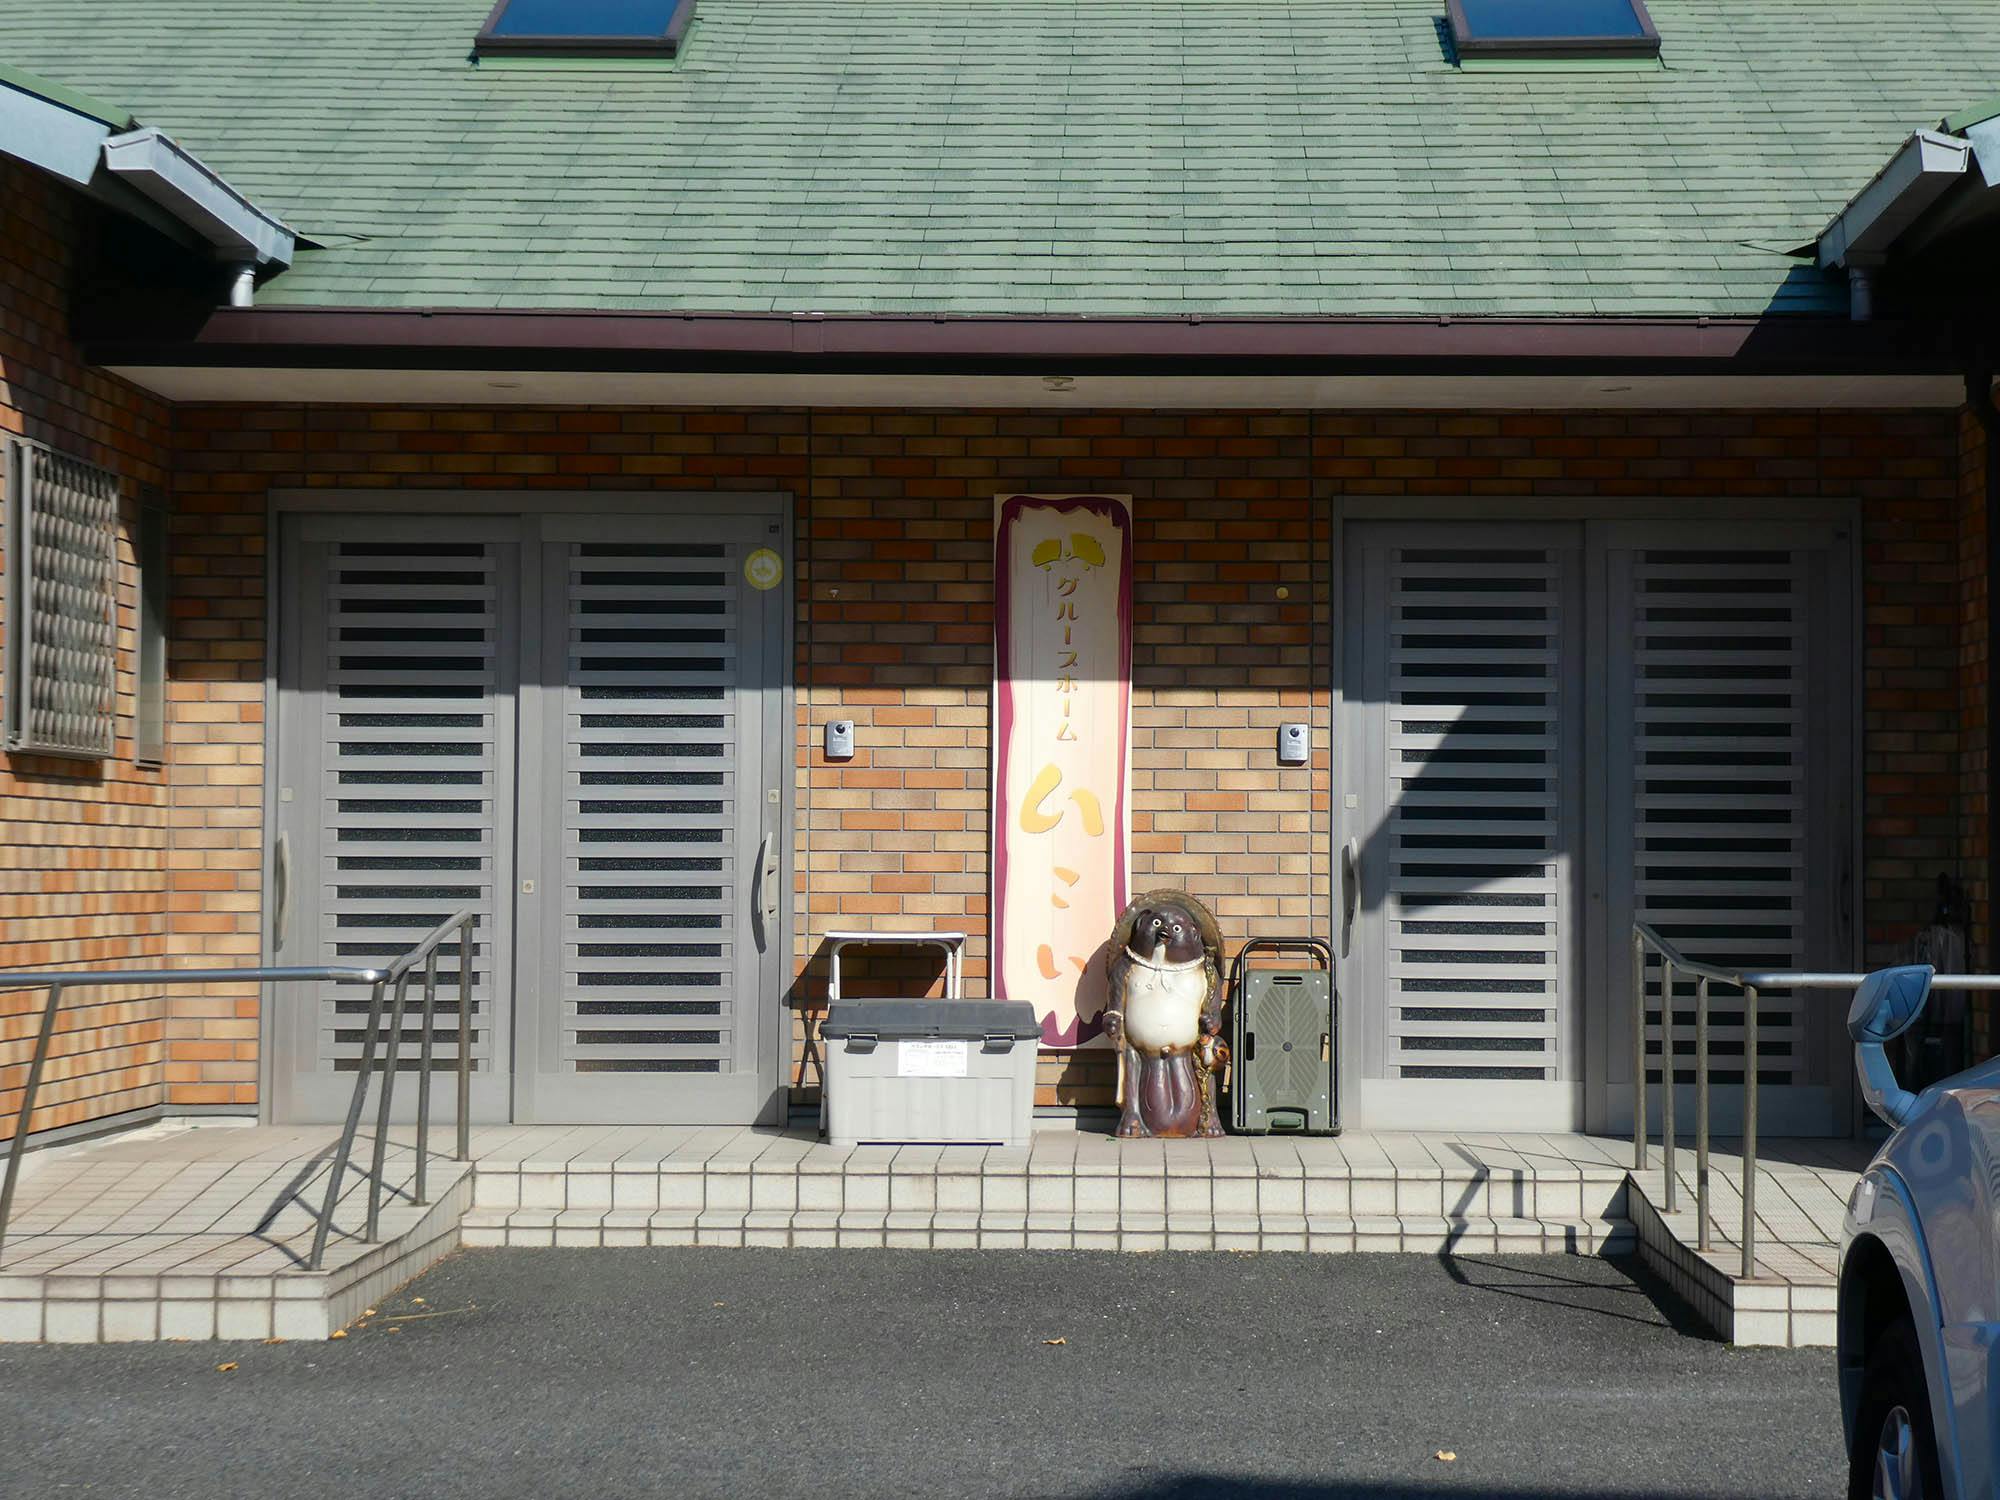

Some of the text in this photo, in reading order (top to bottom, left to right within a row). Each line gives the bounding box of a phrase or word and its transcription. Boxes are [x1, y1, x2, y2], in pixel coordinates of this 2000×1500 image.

[1056, 576, 1080, 742] グループホーム
[1019, 762, 1105, 980] いこい
